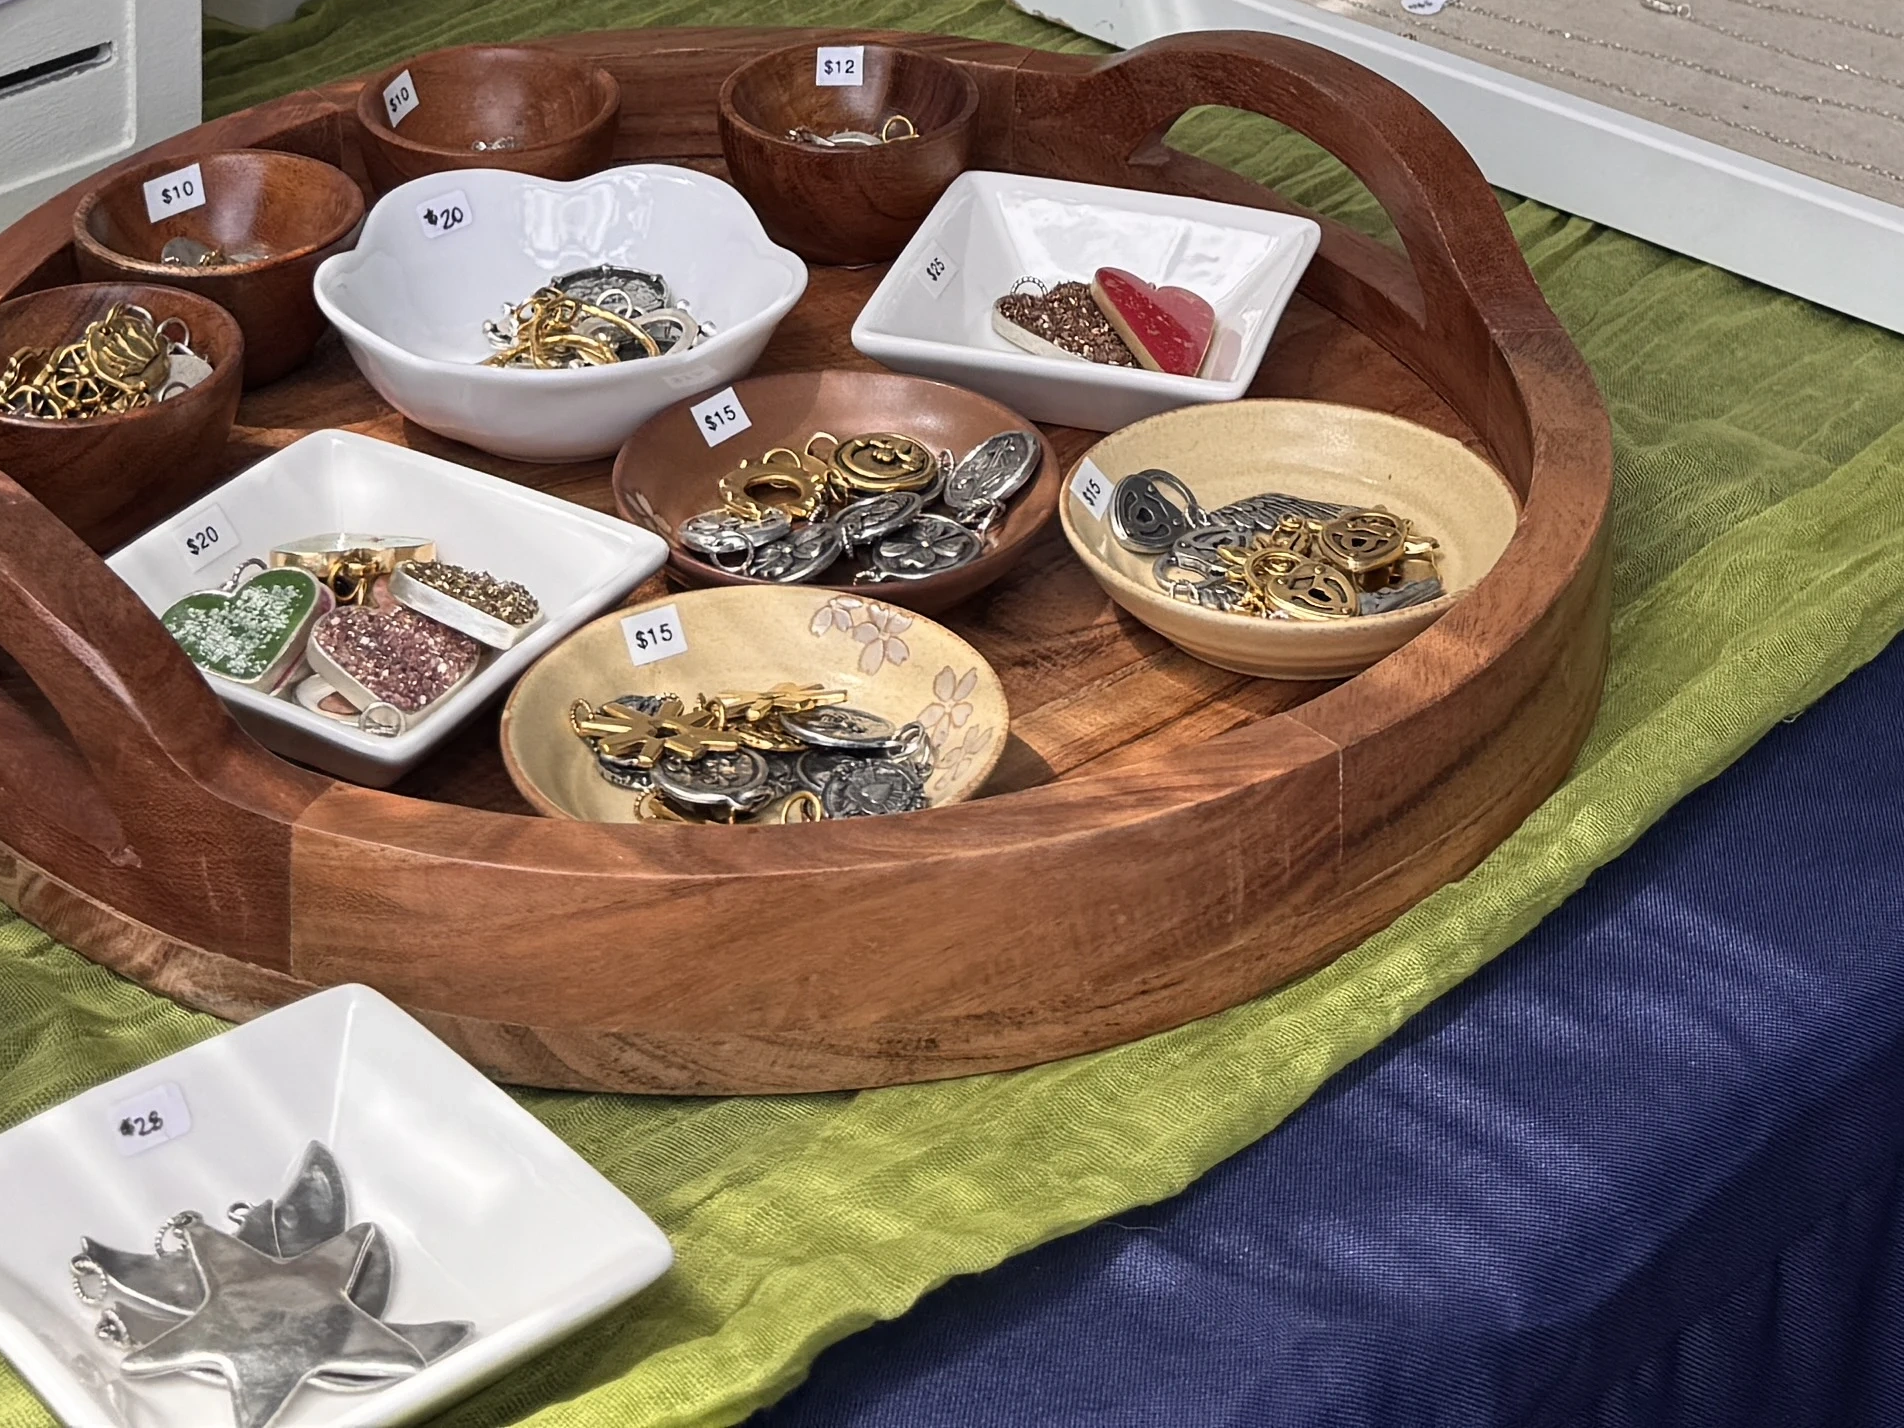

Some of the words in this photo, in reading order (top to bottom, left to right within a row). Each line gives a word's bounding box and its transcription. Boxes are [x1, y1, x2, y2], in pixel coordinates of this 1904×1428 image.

[824, 59, 855, 75] $12
[389, 87, 410, 113] $10
[161, 180, 194, 205] $10
[926, 257, 946, 282] $25
[704, 404, 736, 431] $15
[1082, 478, 1101, 507] $15
[186, 526, 219, 556] $20
[635, 623, 673, 650] $15
